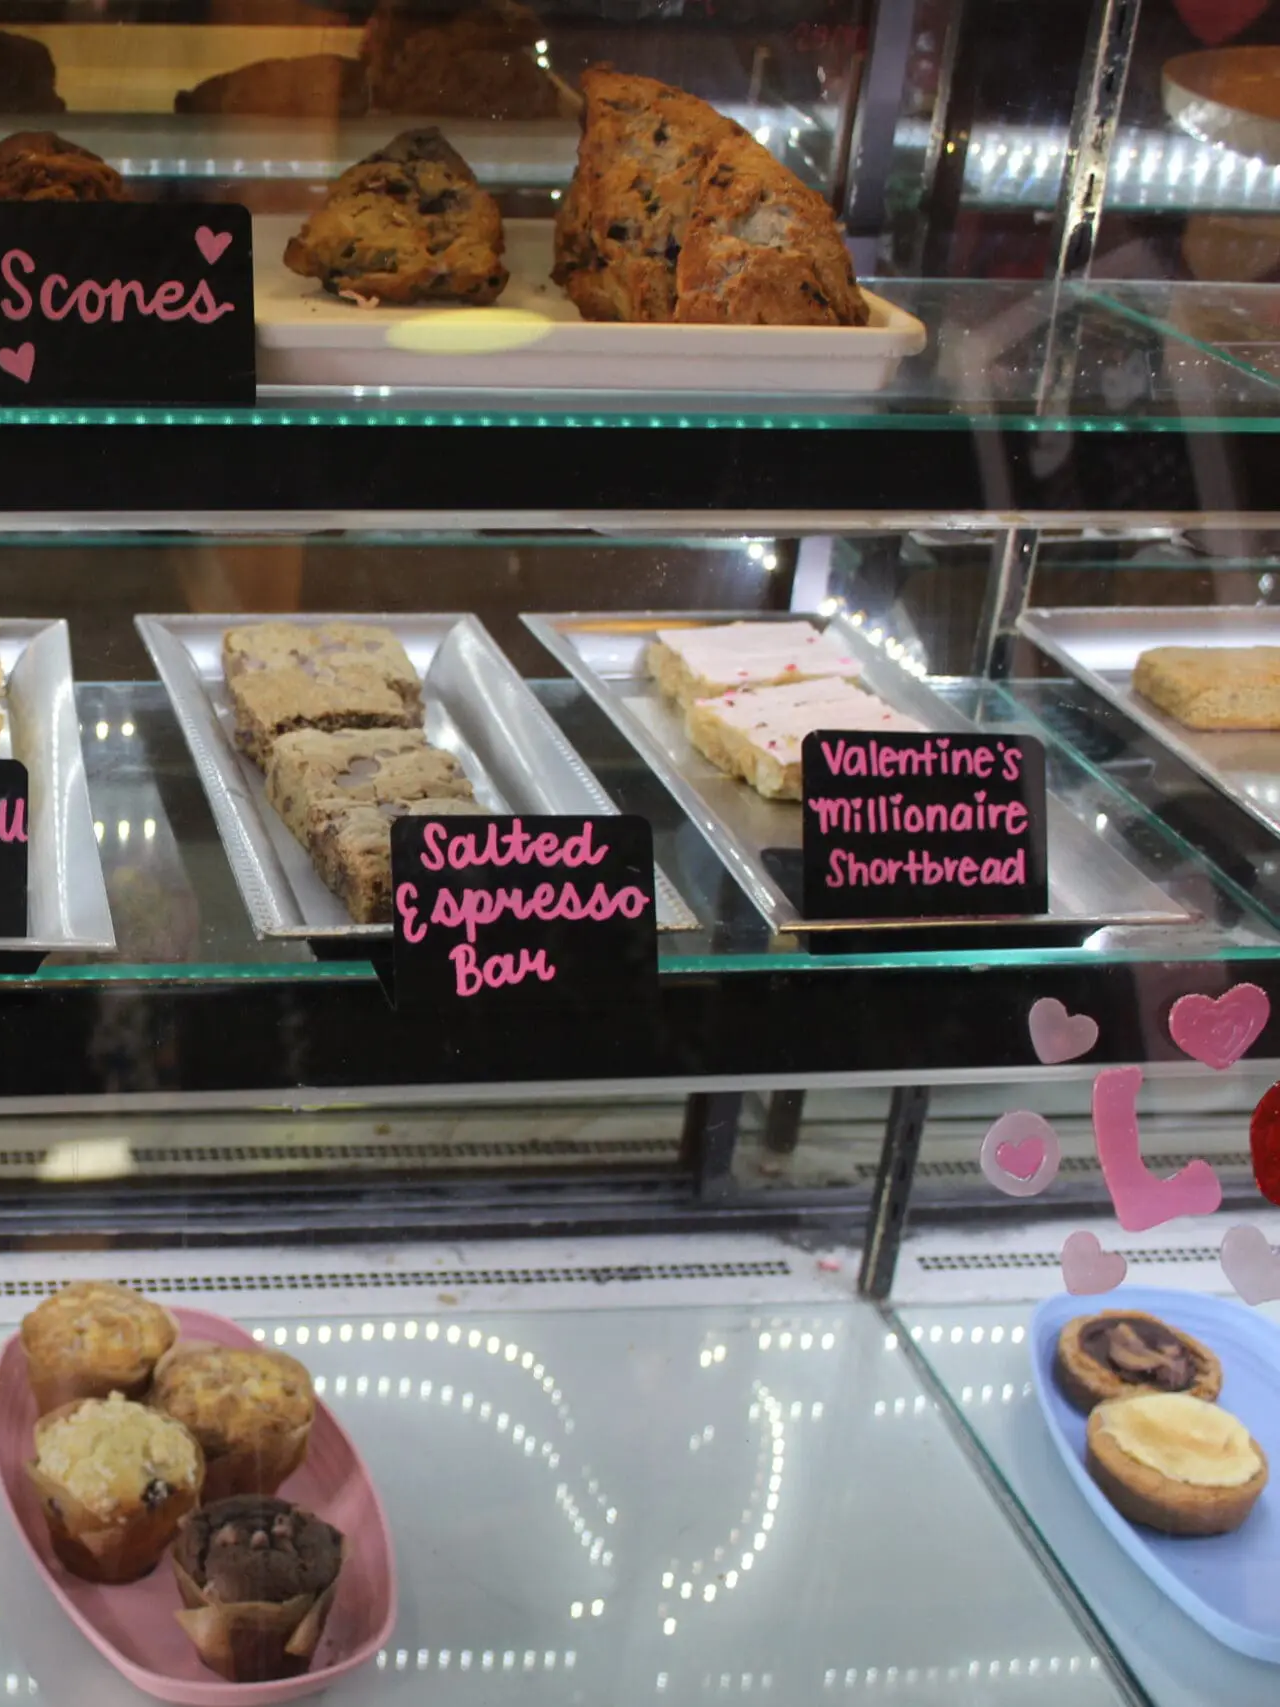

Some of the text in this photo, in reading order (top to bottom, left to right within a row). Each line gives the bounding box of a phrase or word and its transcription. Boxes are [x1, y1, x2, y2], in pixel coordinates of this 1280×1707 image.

[1, 249, 235, 324] Scones
[819, 738, 1023, 782] Valentine's
[807, 790, 1029, 836] Millionaire
[419, 817, 609, 871] Salted
[825, 847, 1027, 888] Shortbread
[395, 881, 652, 944] Espresso
[448, 942, 557, 998] Bar
